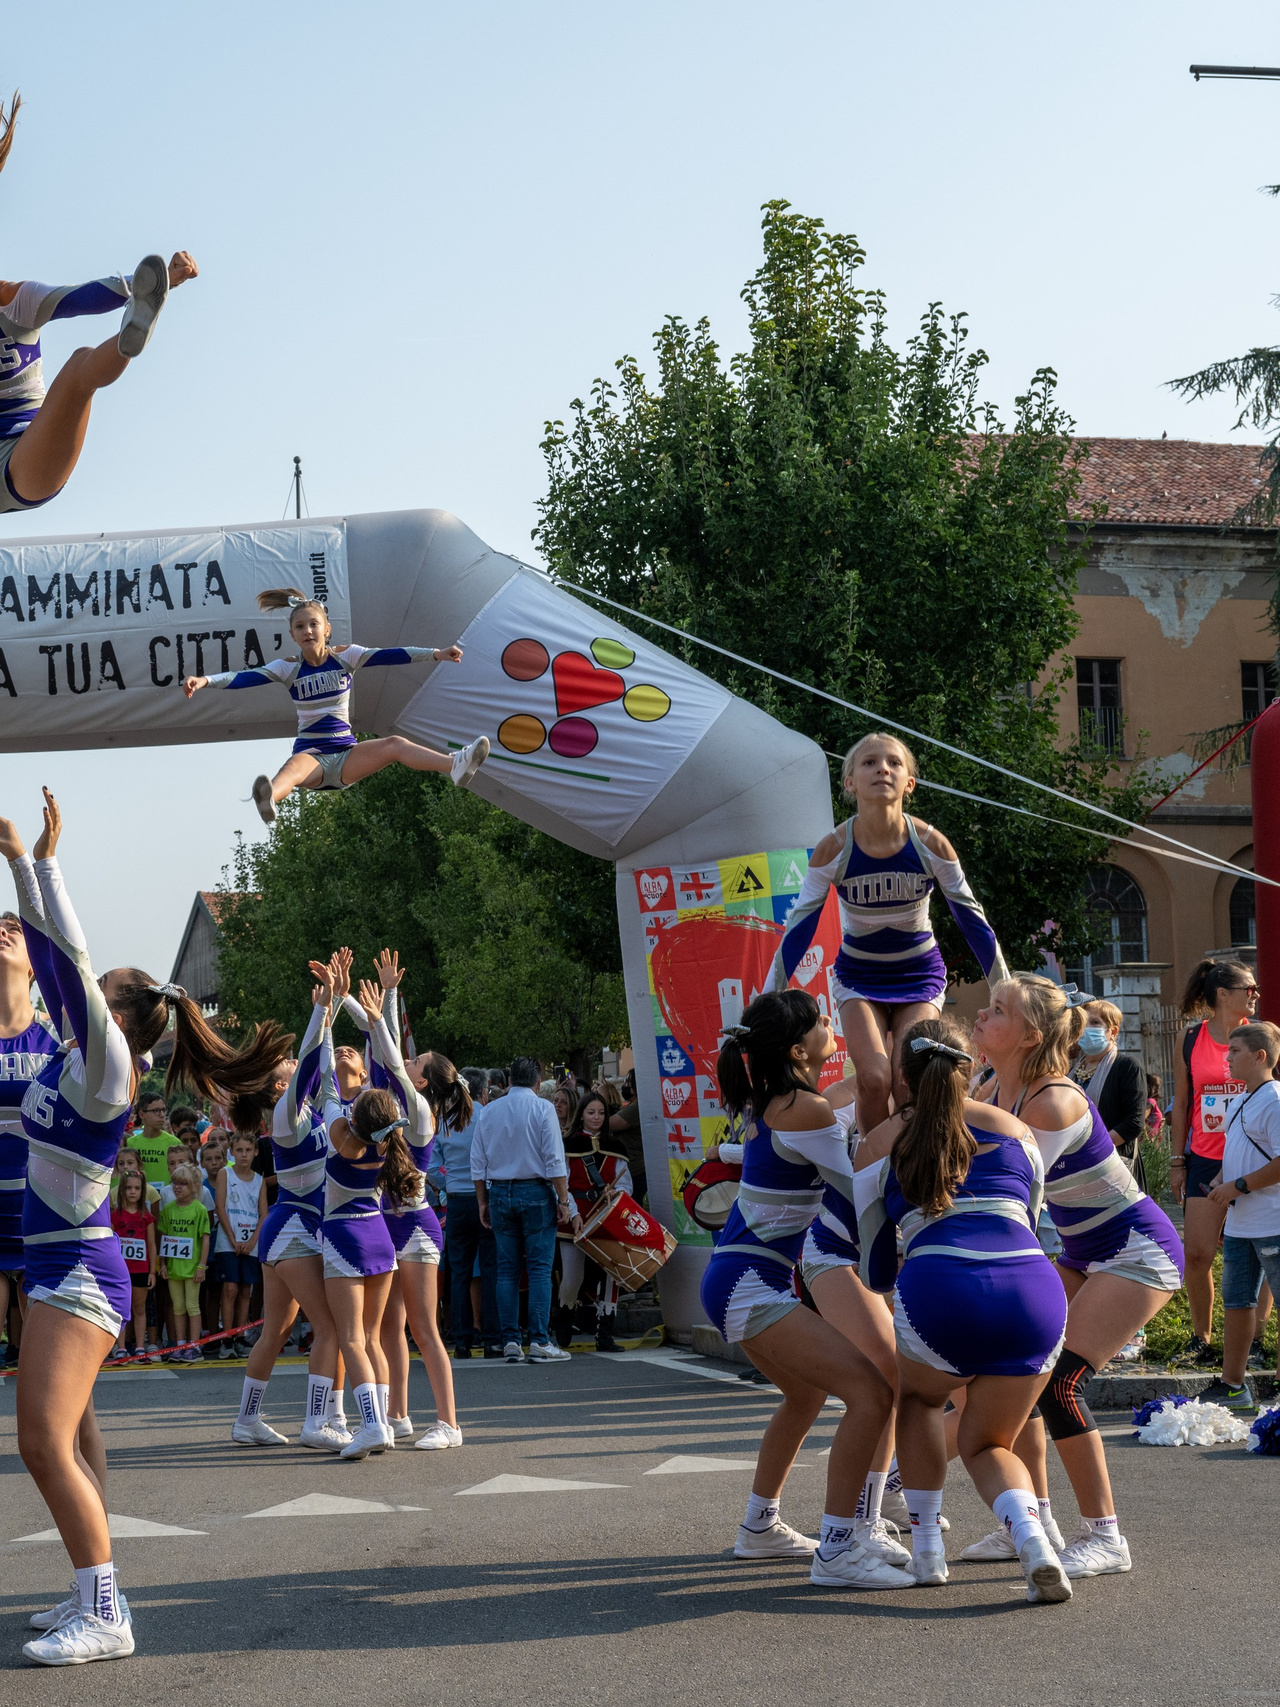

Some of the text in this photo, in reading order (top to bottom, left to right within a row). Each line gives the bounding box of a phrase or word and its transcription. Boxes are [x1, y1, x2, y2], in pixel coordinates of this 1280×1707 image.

[38, 640, 126, 696] TUA
[294, 669, 349, 700] TITANS
[644, 881, 663, 893] ALBA
[841, 872, 928, 903] TITANS
[665, 1088, 685, 1100] ALBA
[1204, 1096, 1216, 1107] 13
[162, 1243, 190, 1258] 114
[247, 1388, 263, 1416] TITANS
[313, 1385, 326, 1416] TITANS
[361, 1391, 374, 1424] TITANS
[98, 1572, 114, 1621] TITANS
